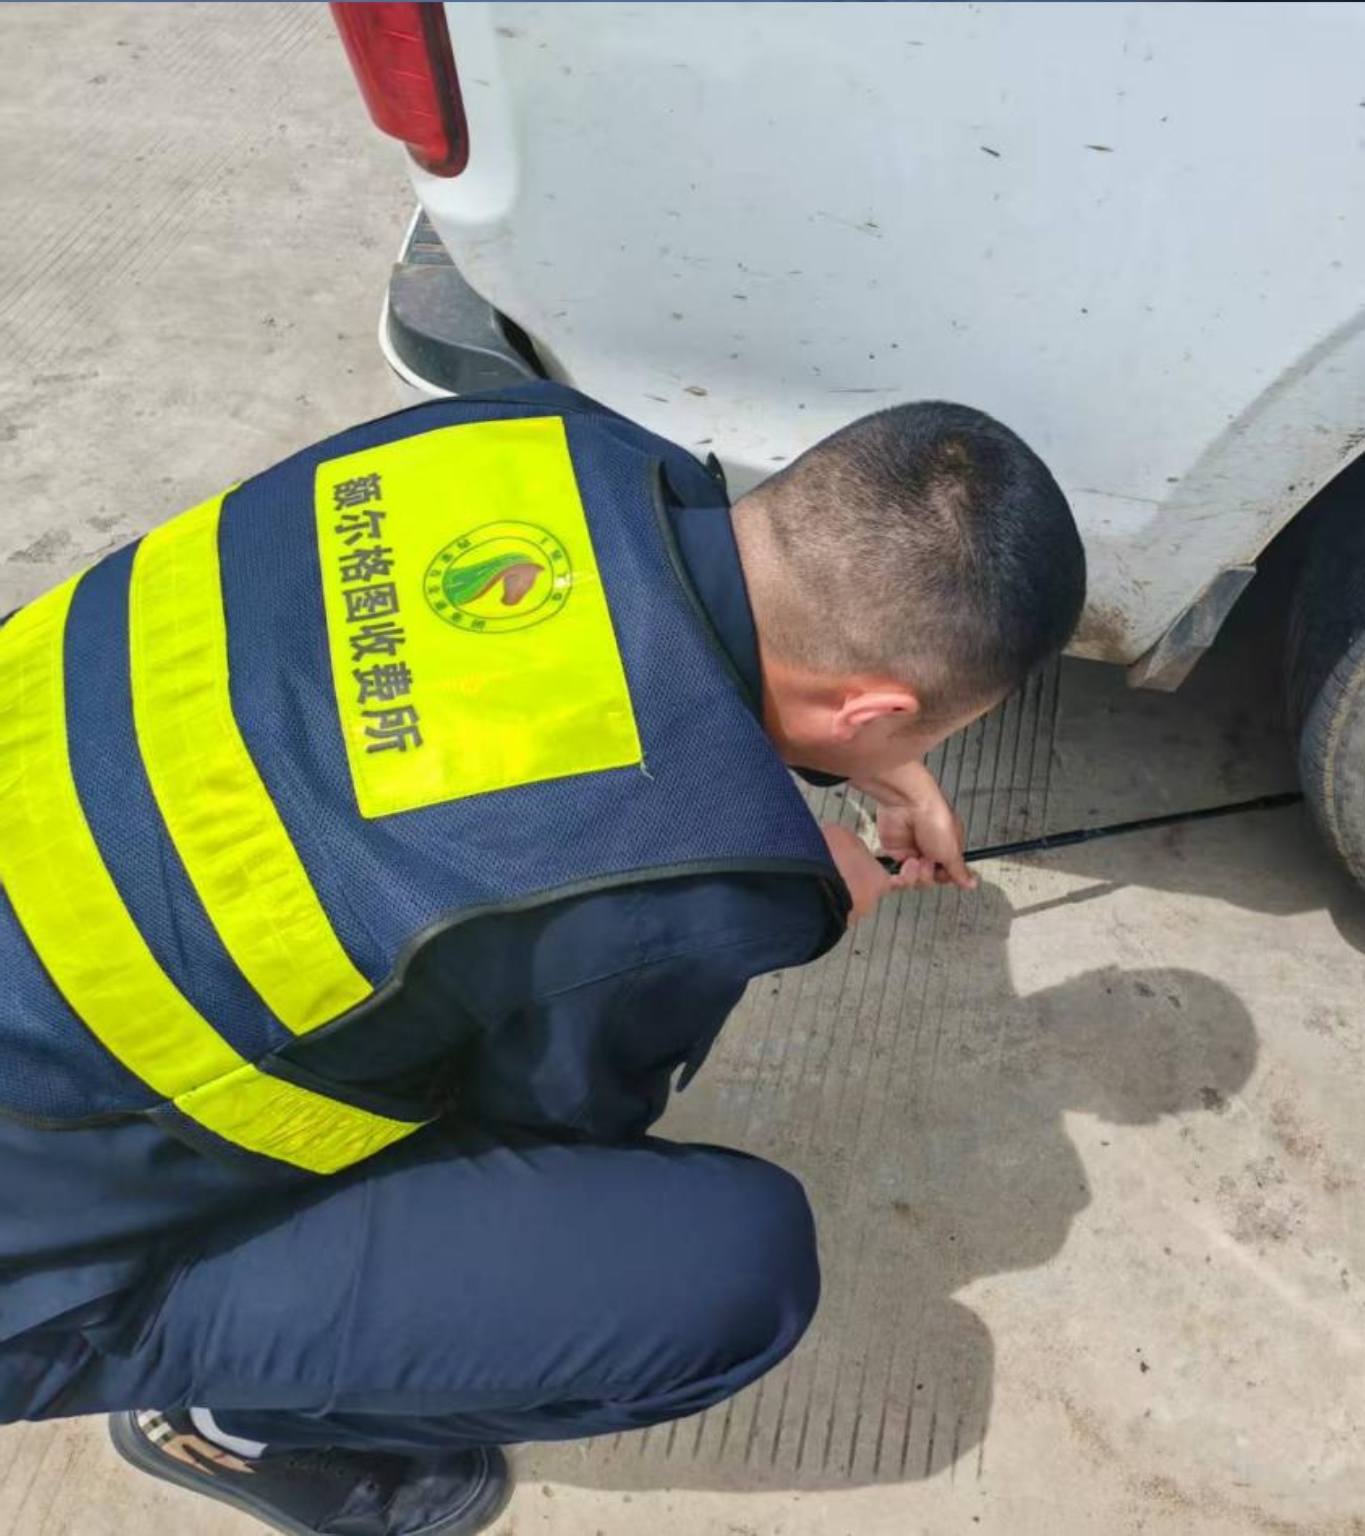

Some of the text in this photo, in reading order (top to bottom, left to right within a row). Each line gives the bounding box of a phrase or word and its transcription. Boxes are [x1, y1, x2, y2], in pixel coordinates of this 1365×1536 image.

[332, 471, 424, 755] 额尔格图收费所
